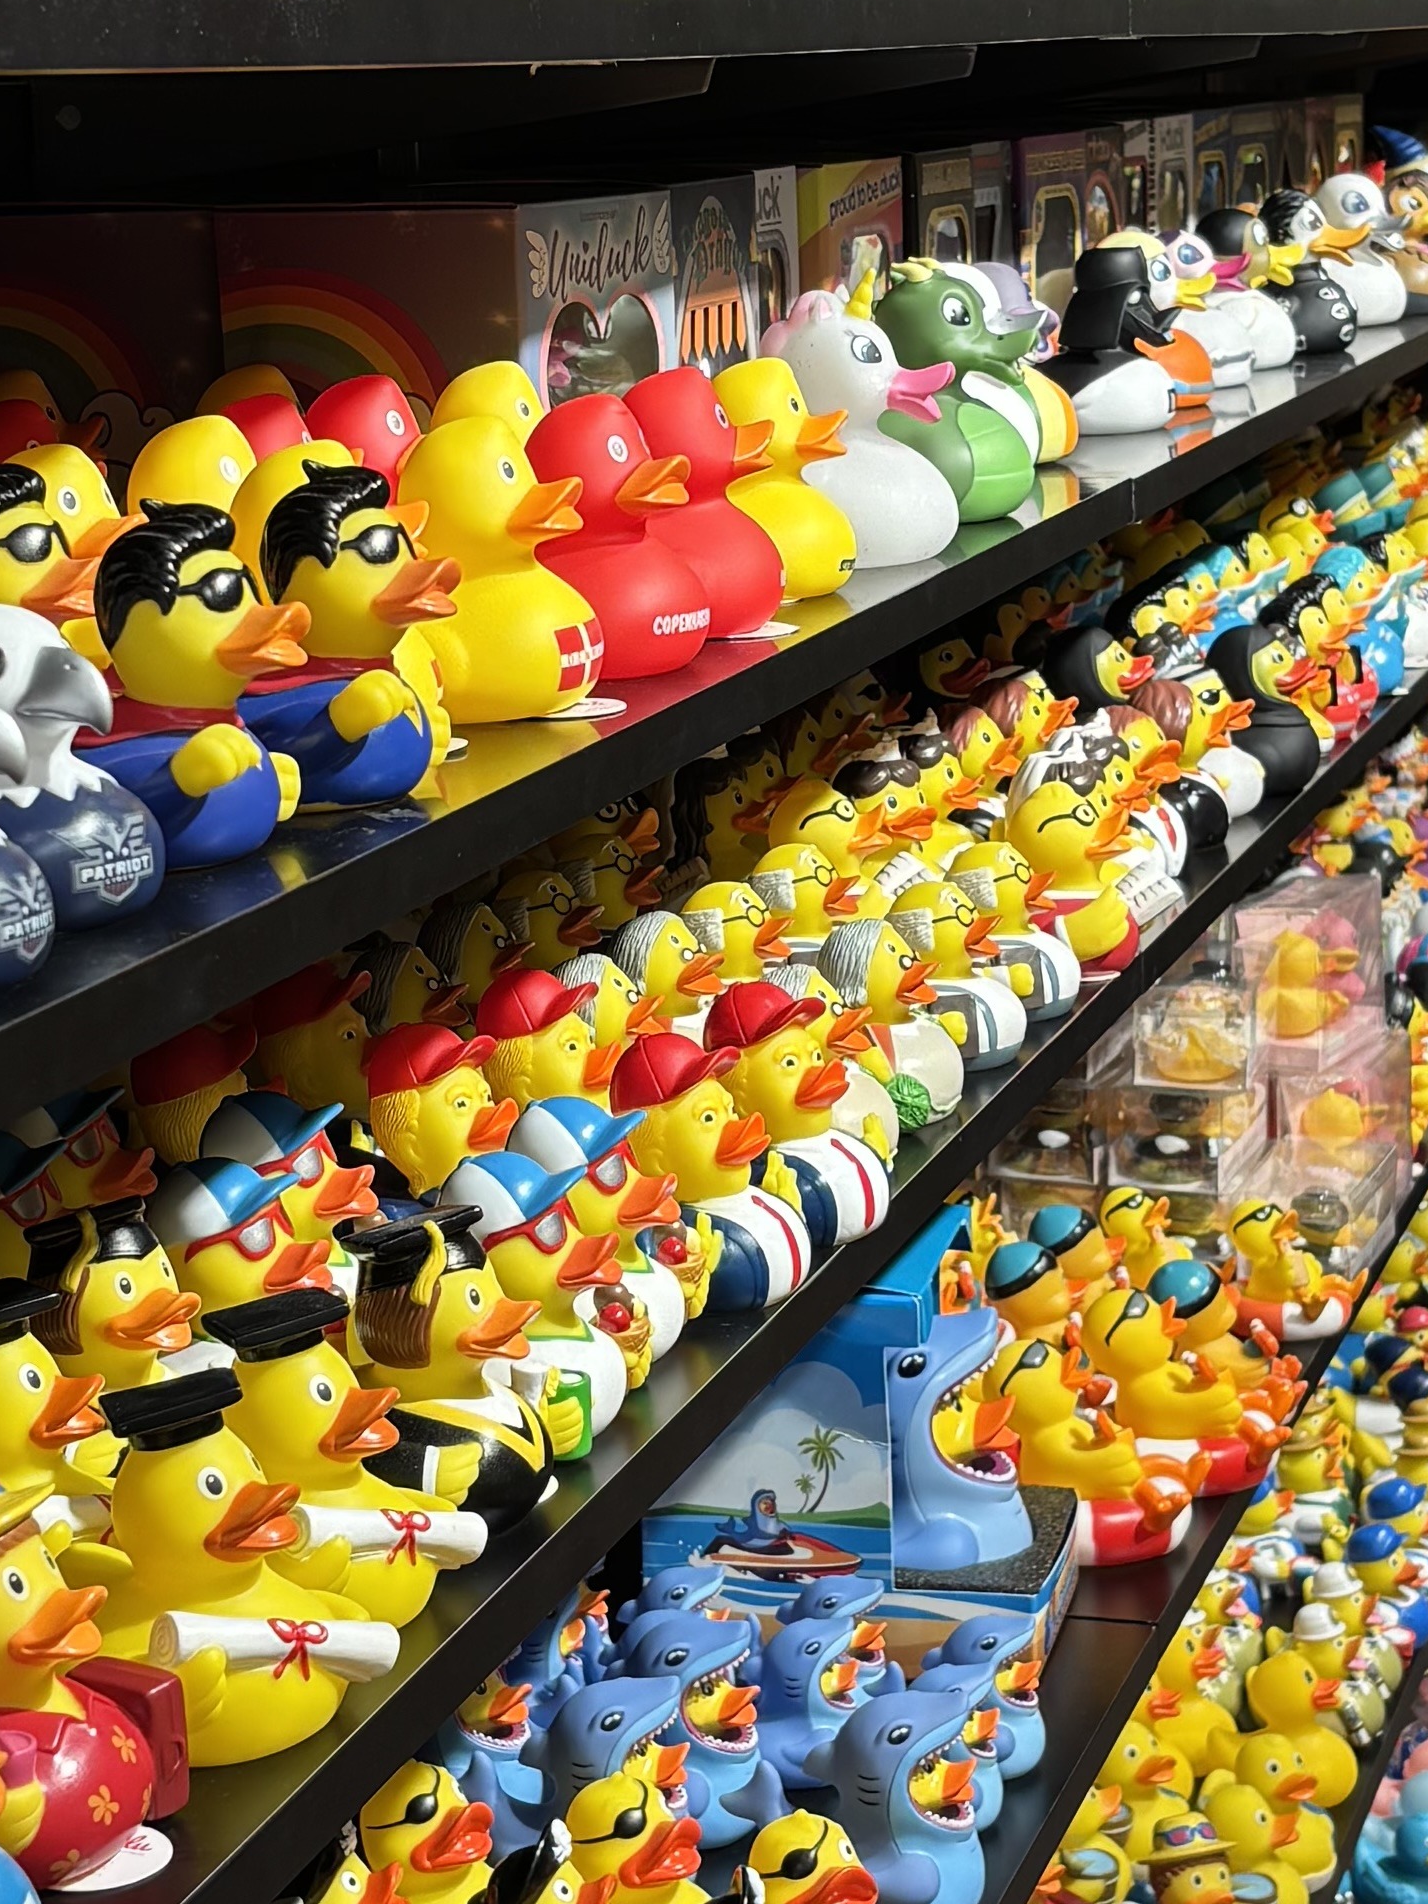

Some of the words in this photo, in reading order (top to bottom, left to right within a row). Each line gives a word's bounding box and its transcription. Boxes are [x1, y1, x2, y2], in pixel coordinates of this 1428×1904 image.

[829, 183, 856, 229] proud
[857, 182, 866, 207] to
[866, 179, 879, 204] be
[548, 204, 652, 303] Uniduck
[80, 855, 150, 884] PATRIOT
